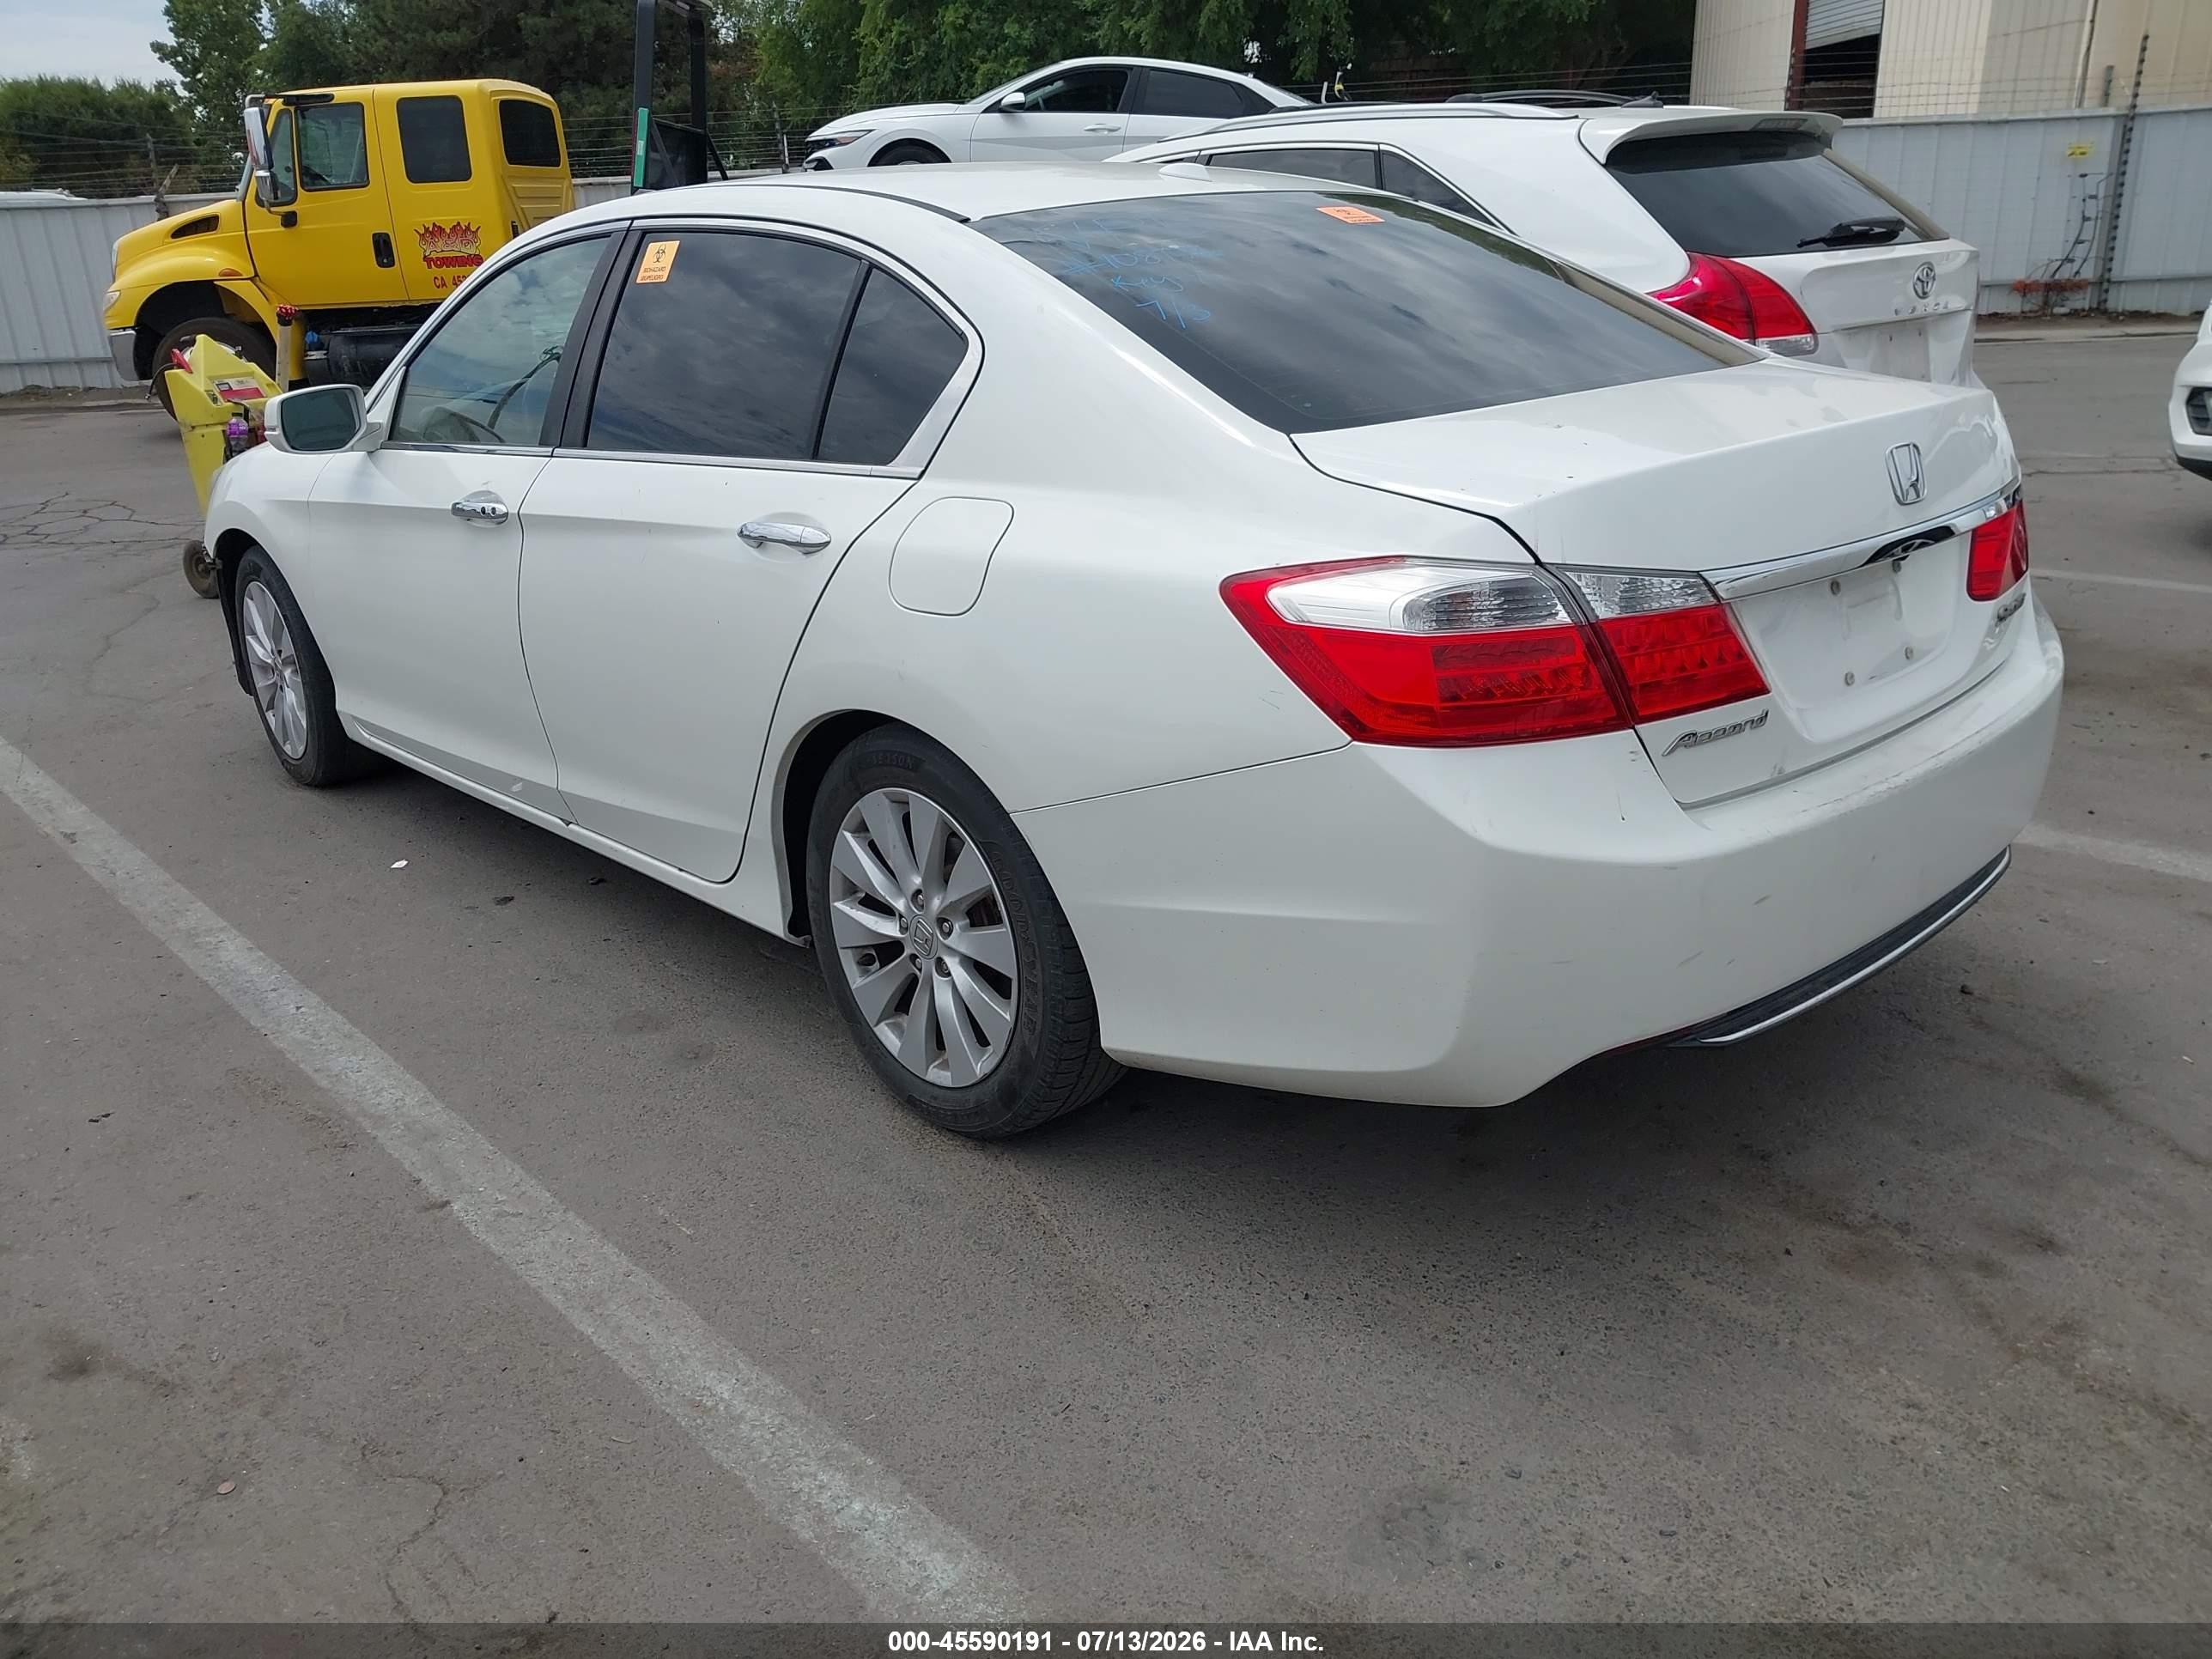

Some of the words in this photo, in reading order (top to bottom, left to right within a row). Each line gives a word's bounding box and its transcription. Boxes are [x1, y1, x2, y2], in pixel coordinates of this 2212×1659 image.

[423, 255, 483, 269] TOWING
[433, 276, 448, 289] CA
[1662, 708, 1769, 757] Accord
